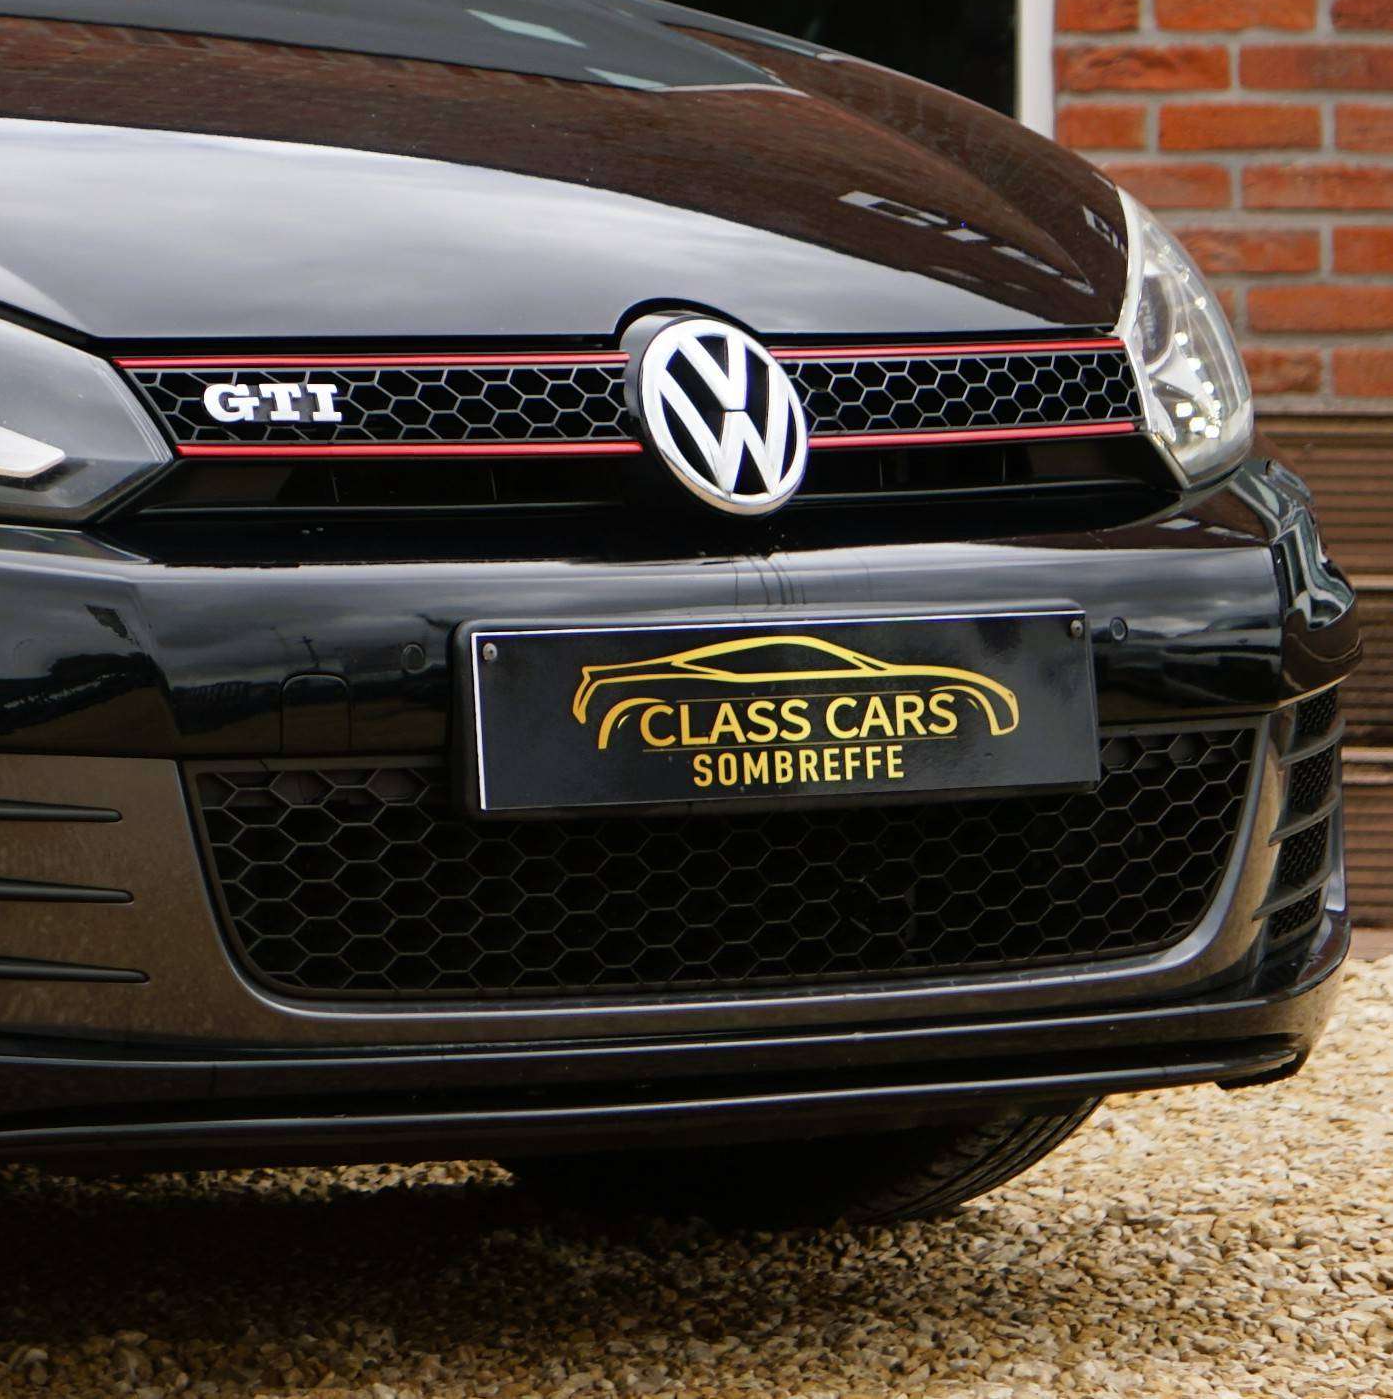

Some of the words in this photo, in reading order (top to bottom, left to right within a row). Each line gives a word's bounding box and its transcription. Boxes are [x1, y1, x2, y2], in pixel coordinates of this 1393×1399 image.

[203, 383, 343, 422] GTI
[639, 698, 813, 747] CLASS
[825, 692, 959, 740] CARS
[692, 744, 905, 788] SOMBREFFE
